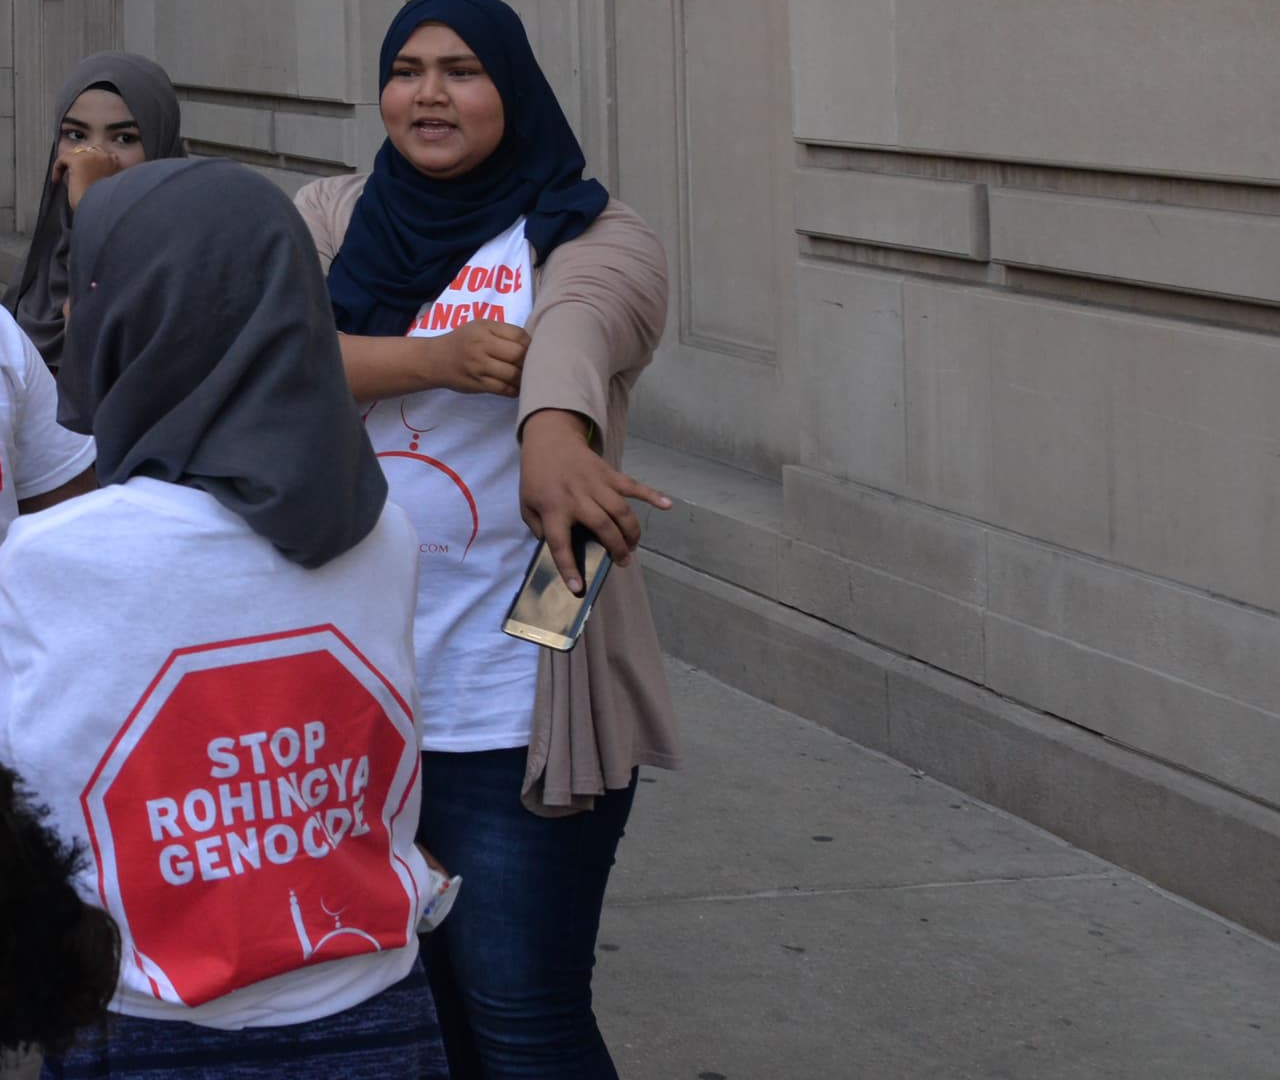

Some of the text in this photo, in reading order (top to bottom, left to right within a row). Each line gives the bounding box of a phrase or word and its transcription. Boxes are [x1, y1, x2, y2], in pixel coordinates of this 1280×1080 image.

[206, 720, 326, 778] STOP
[146, 755, 370, 841] ROHINGYA
[159, 794, 371, 886] GENOCIDE
